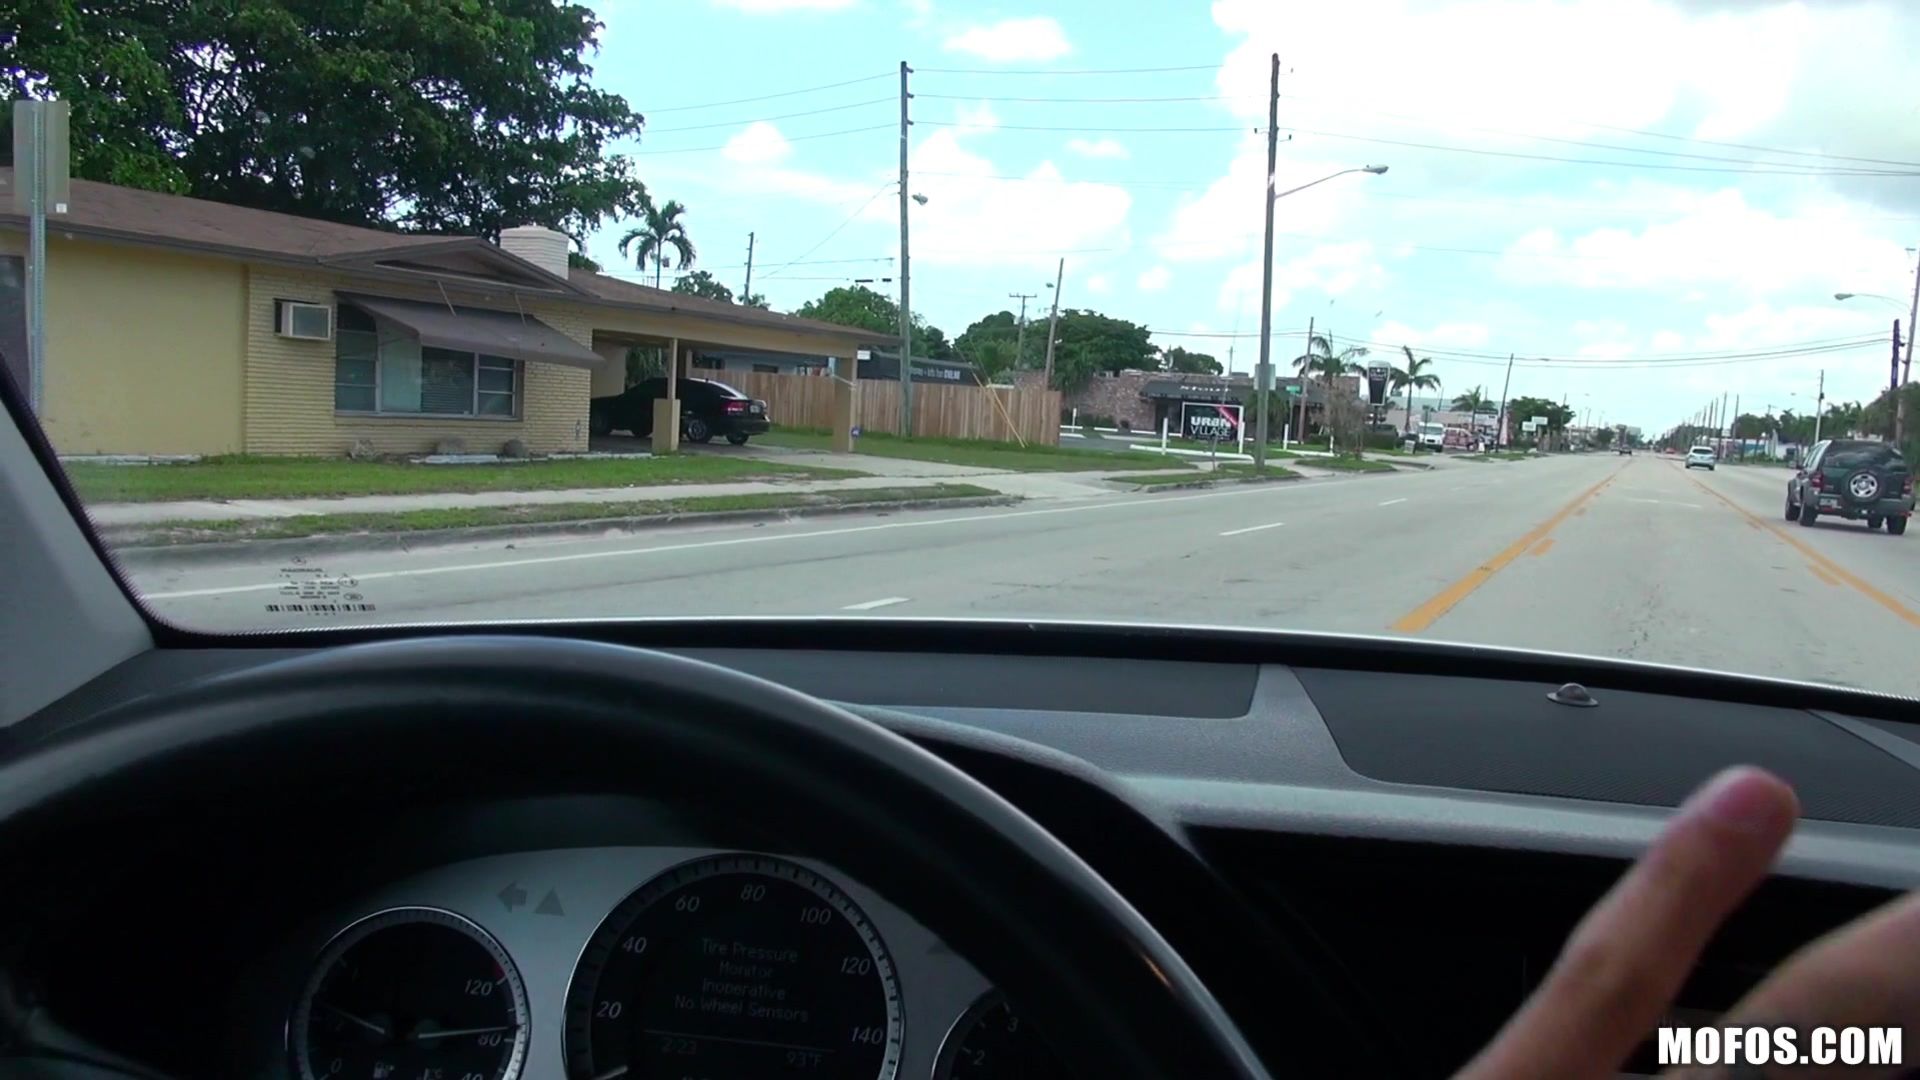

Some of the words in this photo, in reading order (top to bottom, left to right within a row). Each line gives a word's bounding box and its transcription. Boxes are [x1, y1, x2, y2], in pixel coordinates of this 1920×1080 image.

[739, 884, 766, 902] 80
[675, 896, 700, 913] 60
[800, 907, 832, 926] 100
[623, 936, 648, 954] 40
[702, 937, 728, 956] Tire
[733, 941, 798, 963] Pressure
[719, 959, 774, 979] Monitor
[839, 956, 871, 976] 120
[464, 979, 493, 997] 120
[702, 978, 786, 1001] Inoperative
[596, 1000, 623, 1020] 20
[674, 994, 695, 1011] No
[747, 1001, 810, 1024] Sensors
[1007, 1016, 1018, 1033] 3
[850, 1025, 884, 1046] 140
[330, 1058, 342, 1074] 0
[972, 1049, 986, 1067] 2
